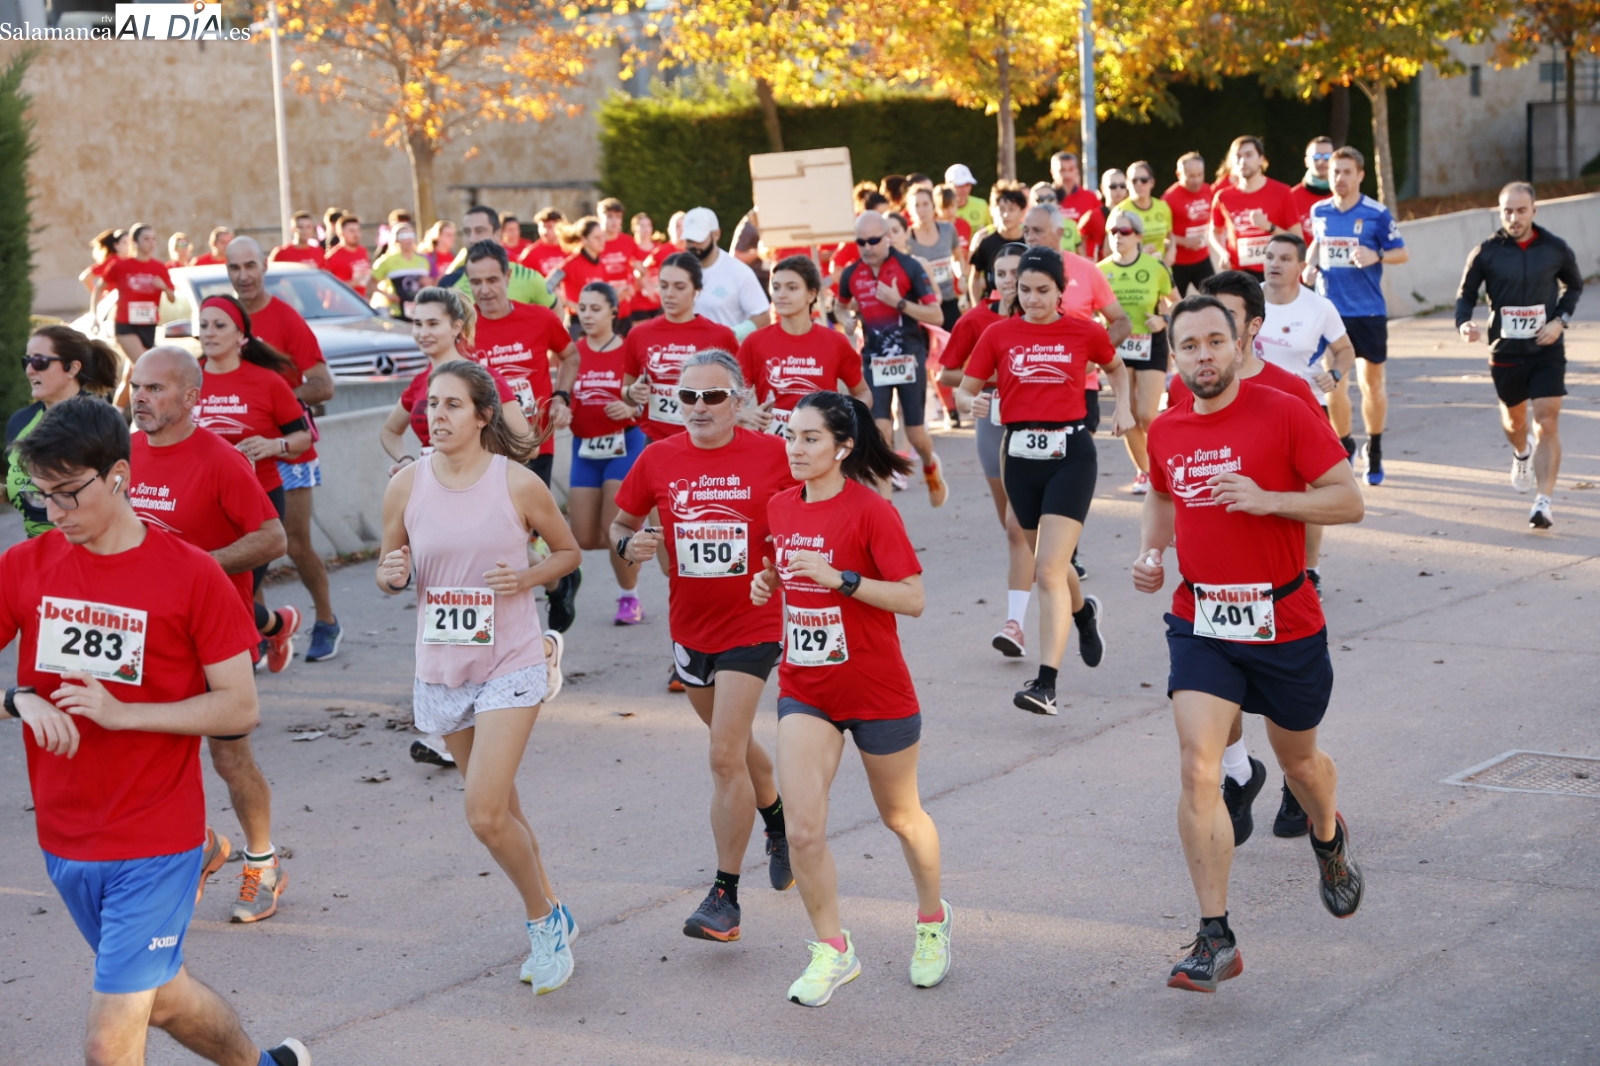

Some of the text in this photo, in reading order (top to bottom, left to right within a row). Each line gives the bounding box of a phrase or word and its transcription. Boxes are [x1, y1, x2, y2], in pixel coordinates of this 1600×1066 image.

[1328, 247, 1350, 259] 341
[1511, 317, 1537, 330] 172
[881, 364, 906, 377] 400
[659, 398, 682, 414] 29
[588, 436, 615, 451] 447
[1026, 433, 1048, 450] 38
[1194, 445, 1232, 464] ¡Corre sin
[1188, 456, 1242, 478] resistencias!
[699, 474, 741, 489] ¡Corre sin
[157, 484, 170, 498] sin
[692, 486, 752, 501] resistencias!
[676, 526, 746, 540] bedunia
[790, 532, 825, 548] ¡Corre sin
[689, 542, 732, 564] 150
[426, 590, 493, 606] bedunia
[44, 601, 144, 634] bedunia
[435, 607, 477, 631] 210
[1211, 604, 1255, 626] 401
[61, 626, 124, 662] 283
[792, 627, 828, 652] 129
